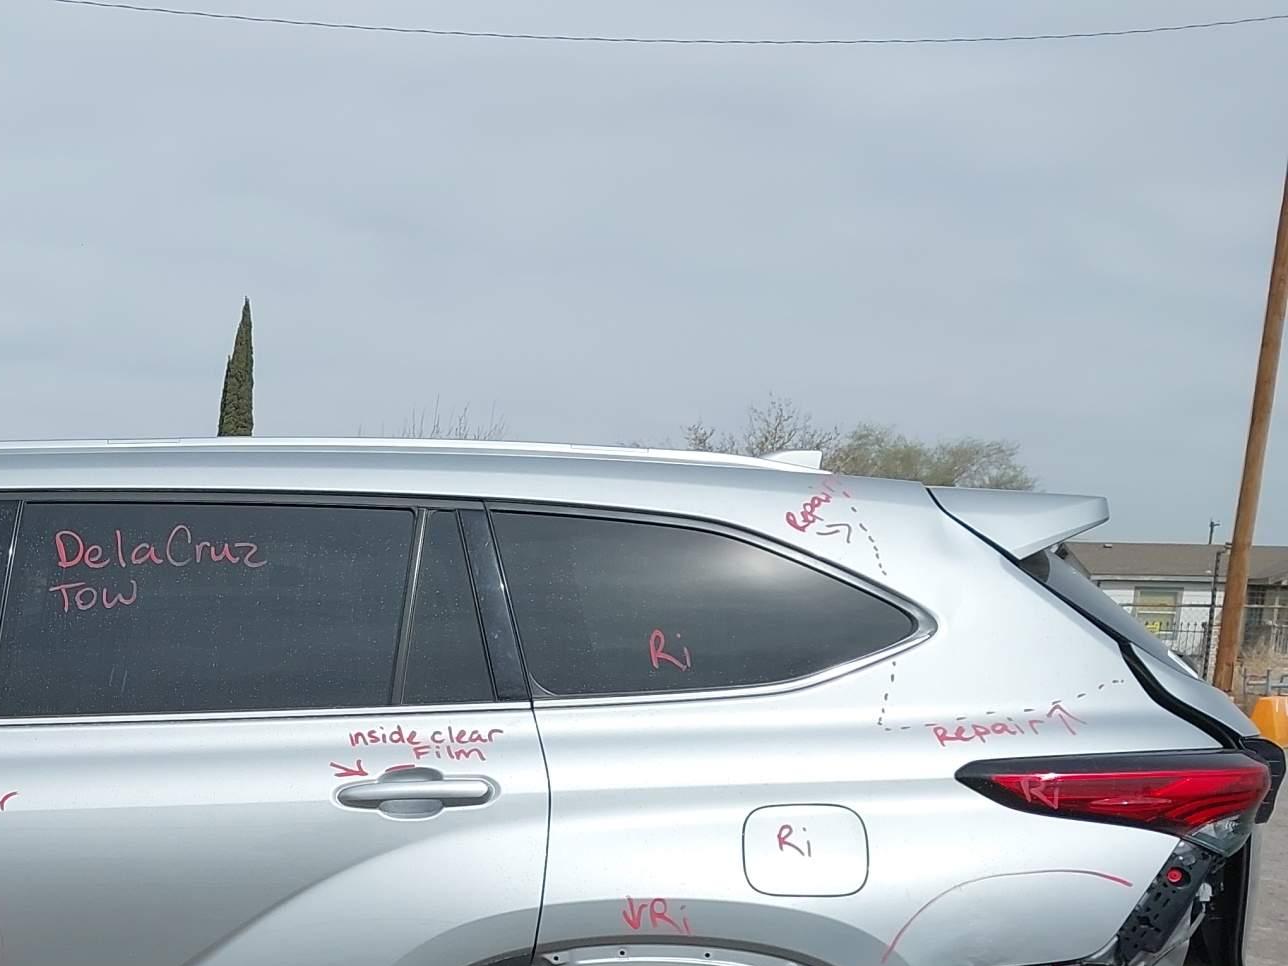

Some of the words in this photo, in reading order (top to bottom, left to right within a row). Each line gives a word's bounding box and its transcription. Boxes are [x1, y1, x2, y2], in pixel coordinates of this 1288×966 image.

[649, 628, 691, 672] Ri
[430, 726, 504, 744] clear
[932, 716, 1045, 747] Repair
[777, 824, 812, 857] Ri
